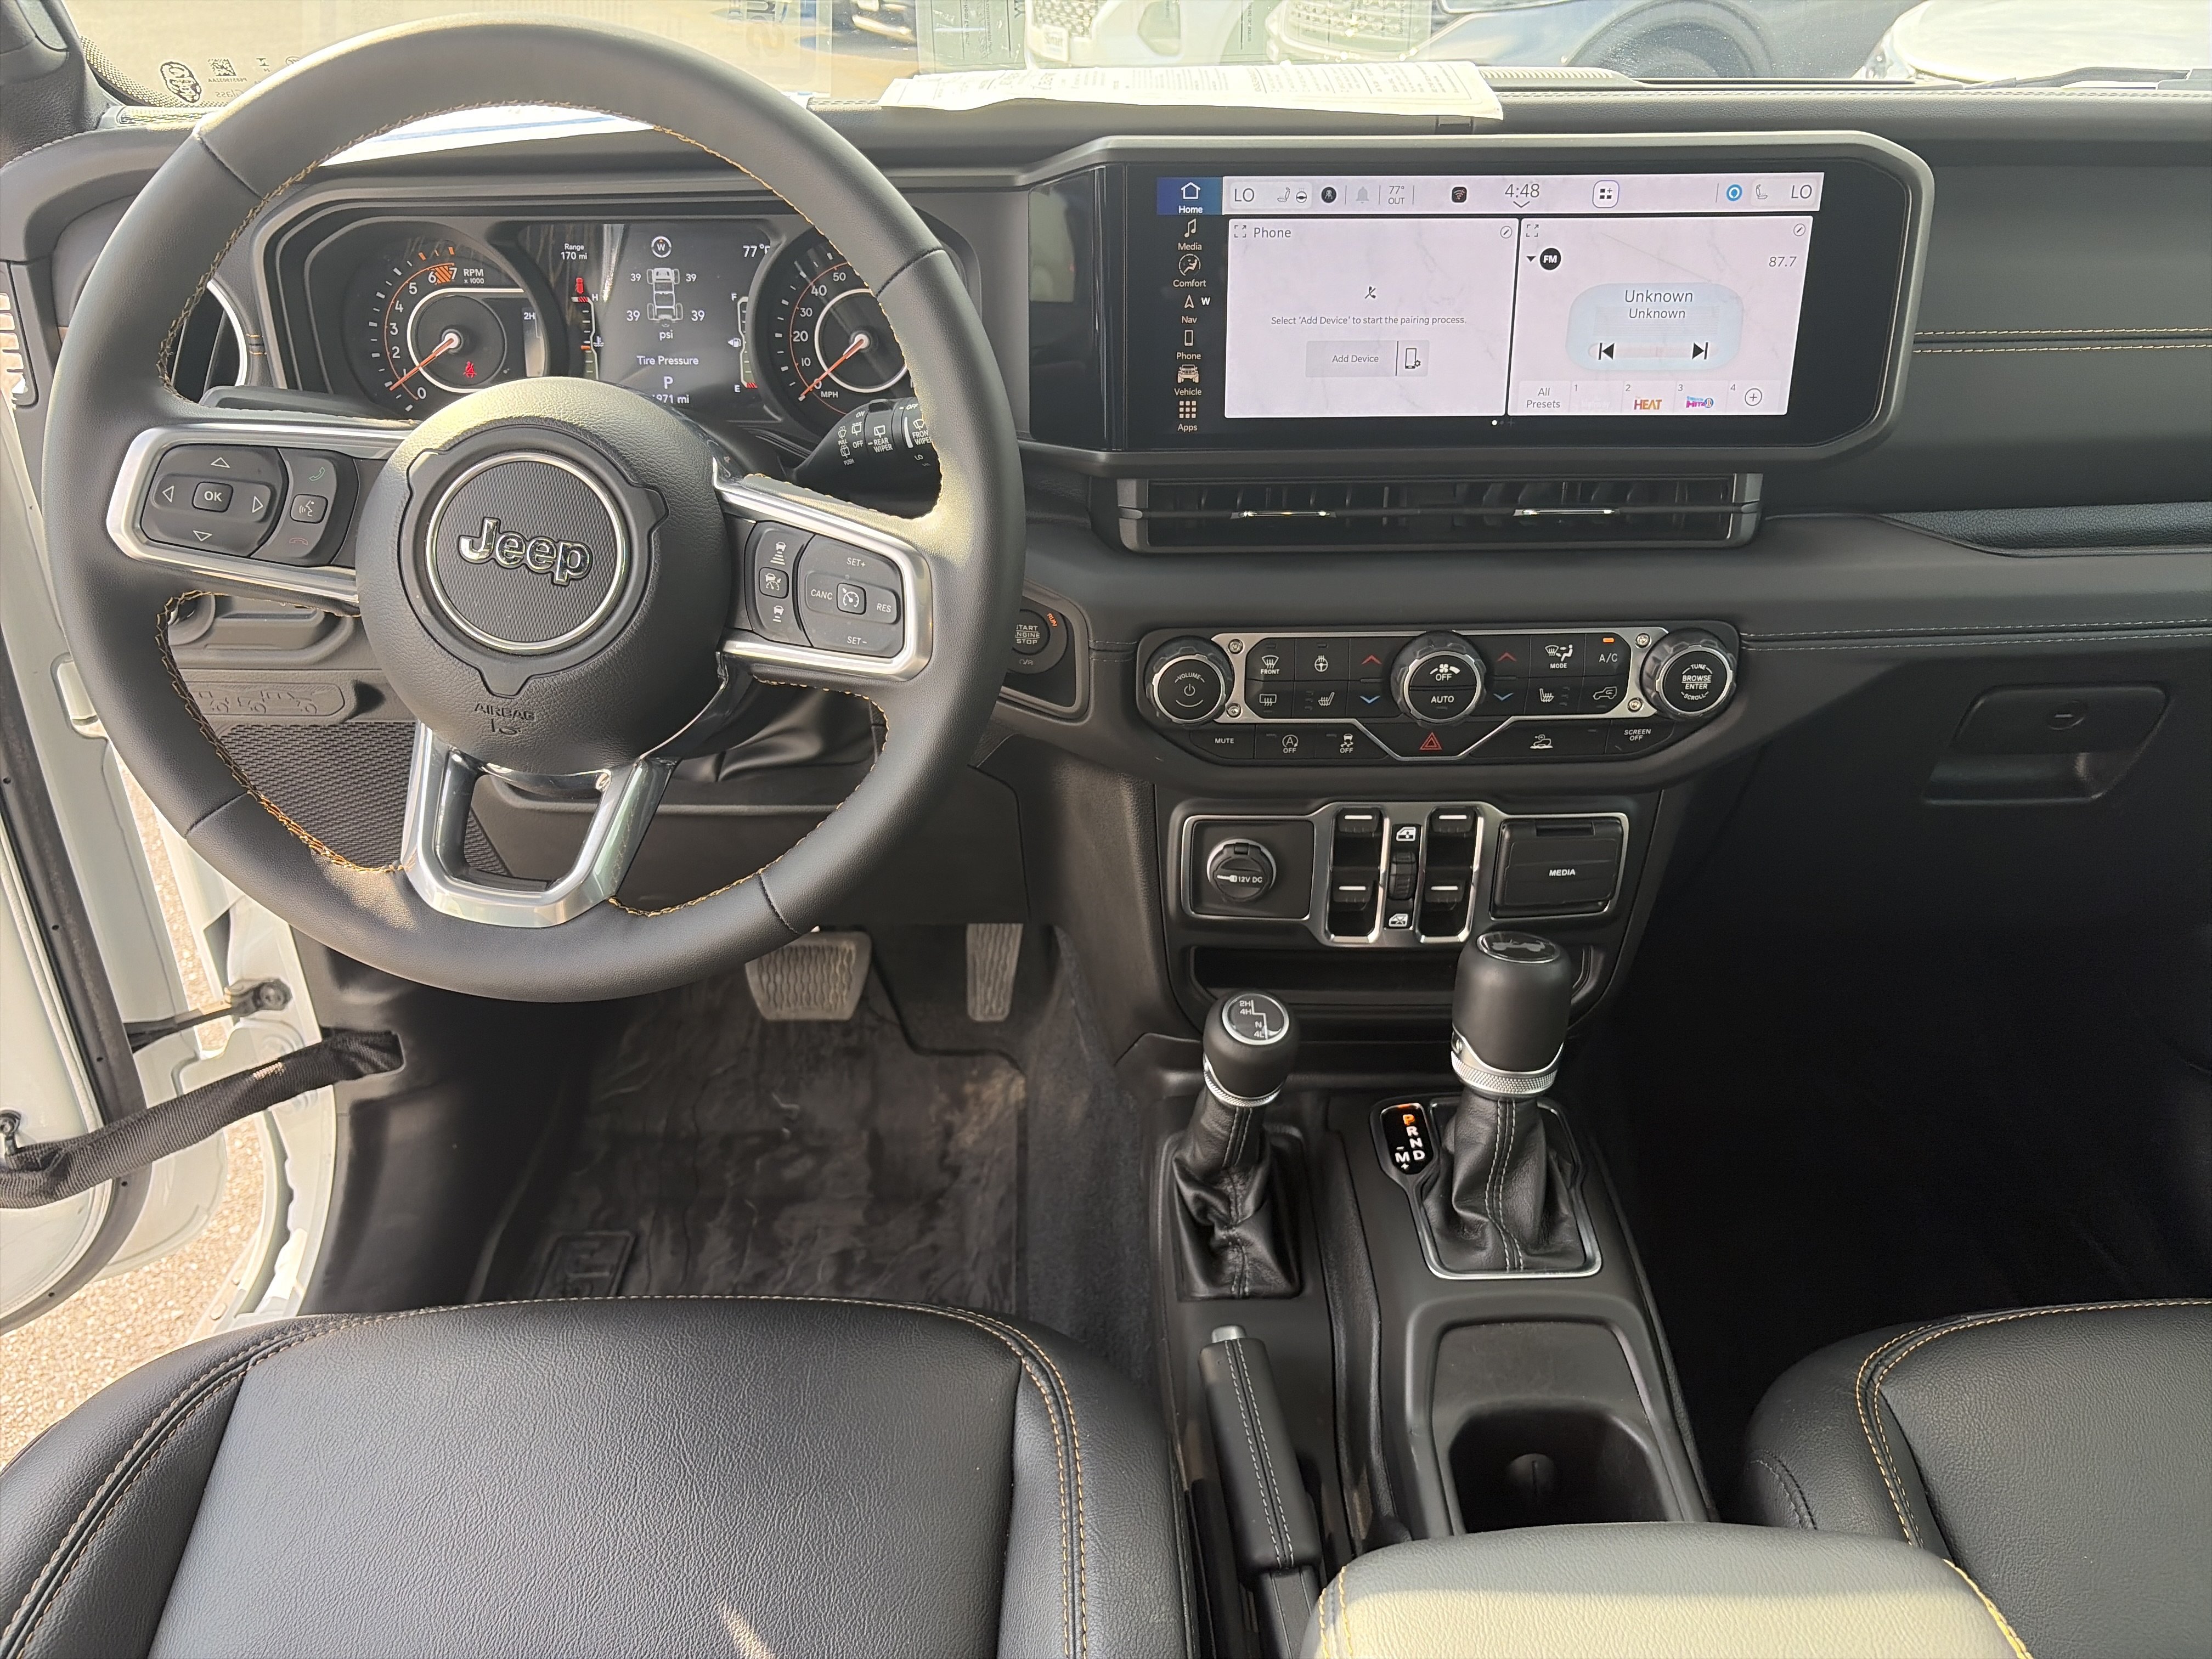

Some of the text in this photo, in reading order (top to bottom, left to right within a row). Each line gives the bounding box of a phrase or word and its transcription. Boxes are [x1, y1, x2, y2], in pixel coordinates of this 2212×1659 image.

[1389, 185, 1405, 194] 77°
[1504, 183, 1540, 199] 4:48
[1791, 184, 1812, 199] LO
[1234, 188, 1255, 202] LO
[1178, 205, 1203, 214] Home
[1254, 227, 1291, 239] Phone
[564, 243, 584, 251] Range
[1178, 242, 1202, 251] Media
[561, 251, 577, 260] 170
[1543, 255, 1558, 263] FM
[1769, 256, 1797, 267] 87.7
[428, 271, 437, 284] 6
[449, 267, 458, 280] 7
[464, 268, 484, 277] RPM
[630, 273, 641, 281] 39
[686, 273, 697, 282] 39
[832, 272, 847, 281] 50
[409, 282, 417, 295] 5
[1173, 279, 1206, 288] Comfort
[811, 284, 827, 296] 40
[731, 293, 737, 301] F
[1201, 297, 1210, 306] W
[1624, 290, 1694, 303] Unknown
[395, 300, 404, 313] 4
[627, 311, 640, 321] 39
[691, 310, 705, 321] 39
[799, 308, 813, 317] 30
[1628, 308, 1686, 319] Unknown
[1181, 316, 1197, 324] Nav
[1271, 316, 1296, 325] Select
[1352, 317, 1361, 325] to
[1363, 316, 1383, 325] start
[1385, 316, 1398, 325] the
[1400, 316, 1430, 327] pairing
[1432, 317, 1466, 327] process.
[390, 323, 398, 335] 3
[659, 330, 674, 341] psi
[793, 330, 809, 342] 20
[392, 346, 400, 359] 2
[1176, 352, 1201, 360] Phone
[636, 356, 699, 365] Tire Pressure
[801, 357, 811, 366] 10
[1332, 354, 1379, 363] Add Device
[664, 376, 673, 389] P
[417, 387, 427, 399] 0
[1174, 387, 1202, 396] Vehicle
[1538, 387, 1550, 397] All
[652, 394, 690, 404] 971 mi
[1526, 399, 1560, 409] Presets
[1634, 399, 1662, 410] HEAT
[1178, 424, 1197, 433] Apps
[912, 430, 929, 439] FRON
[852, 440, 864, 449] OFF
[873, 437, 889, 446] REAR
[914, 437, 932, 445] WIPE
[873, 444, 893, 453] WIPER
[204, 491, 222, 501] OK
[459, 518, 592, 586] Jeep
[847, 557, 866, 568] SET+
[810, 589, 833, 601] CANC
[876, 603, 891, 613] RES
[1047, 613, 1058, 627] RUN
[1599, 652, 1618, 663] A/C
[1177, 673, 1201, 681] VOLUME
[1435, 673, 1452, 681] OFF
[475, 703, 537, 721] AIRBAG
[1548, 868, 1576, 877] MEDIA
[1402, 1114, 1415, 1126] P
[1406, 1126, 1419, 1137] R
[1409, 1137, 1423, 1148] N
[1395, 1151, 1410, 1163] M
[1413, 1150, 1425, 1160] D
